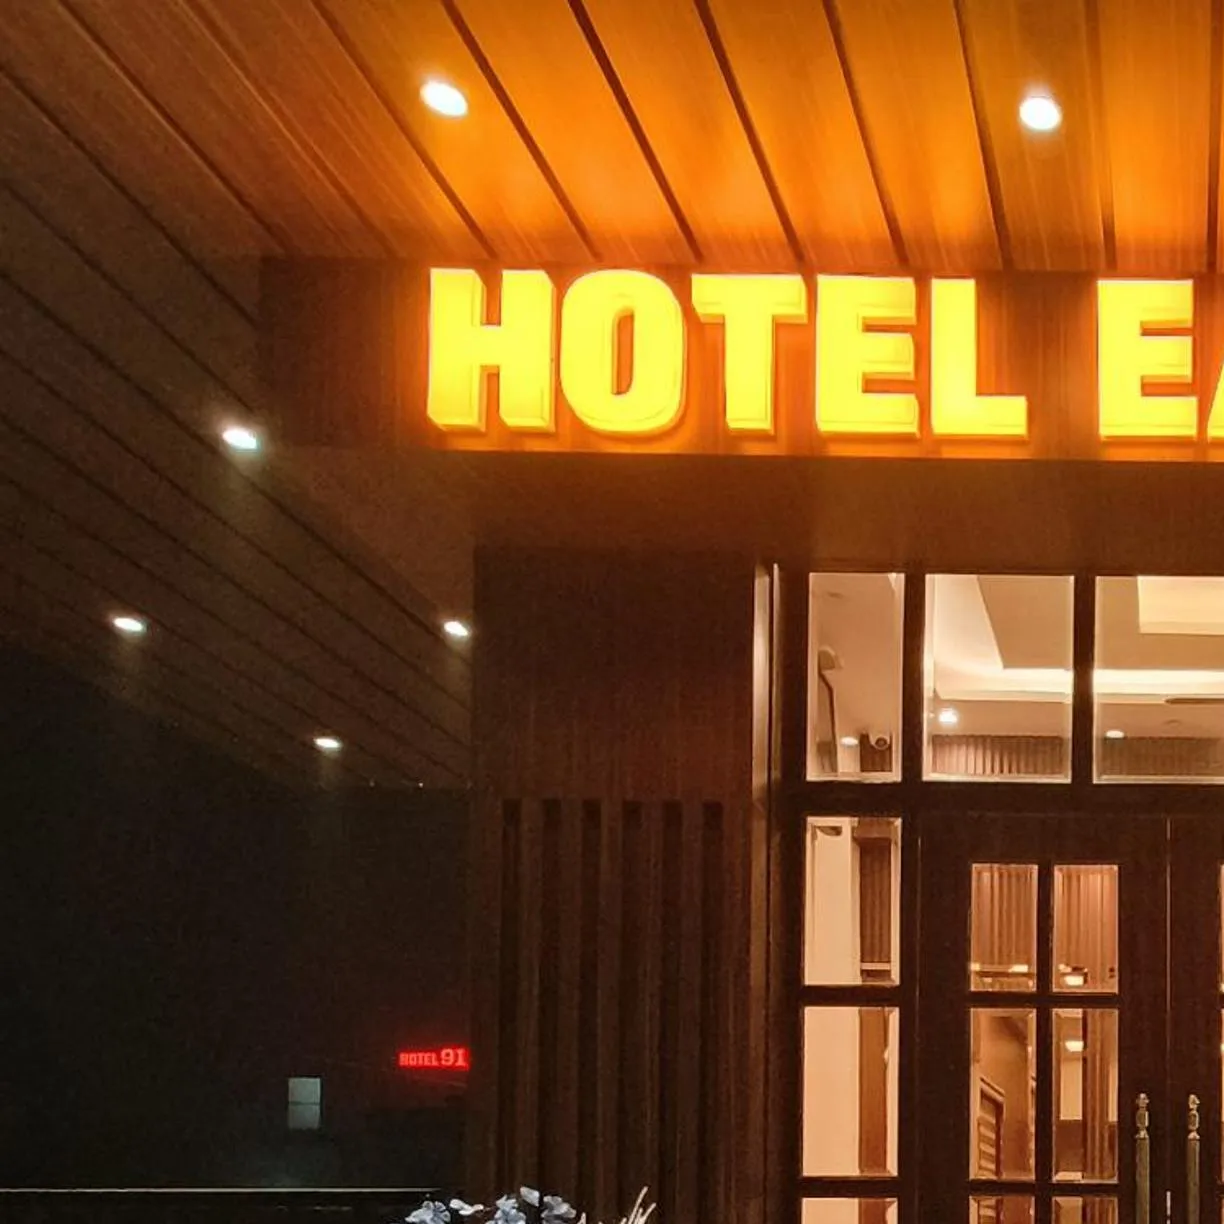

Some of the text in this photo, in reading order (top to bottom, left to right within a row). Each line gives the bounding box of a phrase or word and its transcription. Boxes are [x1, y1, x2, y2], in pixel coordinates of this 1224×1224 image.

[426, 267, 1029, 438] HOTEL
[399, 1047, 467, 1068] HOTEL 91
